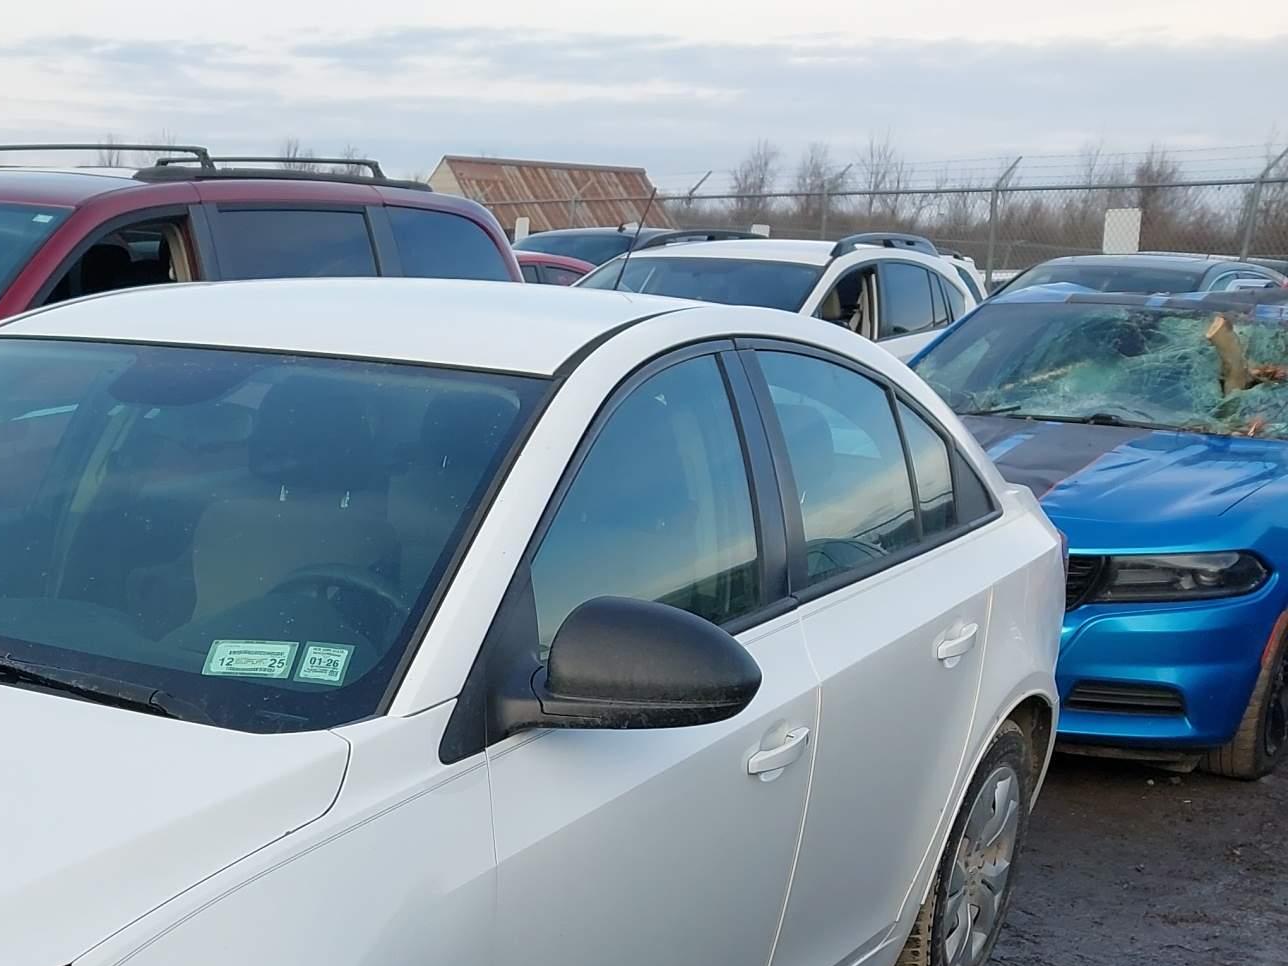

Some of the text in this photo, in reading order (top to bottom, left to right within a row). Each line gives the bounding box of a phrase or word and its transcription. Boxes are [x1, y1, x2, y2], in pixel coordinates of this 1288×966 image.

[218, 657, 234, 667] 12
[268, 658, 286, 669] 25
[309, 656, 340, 668] 01-26
